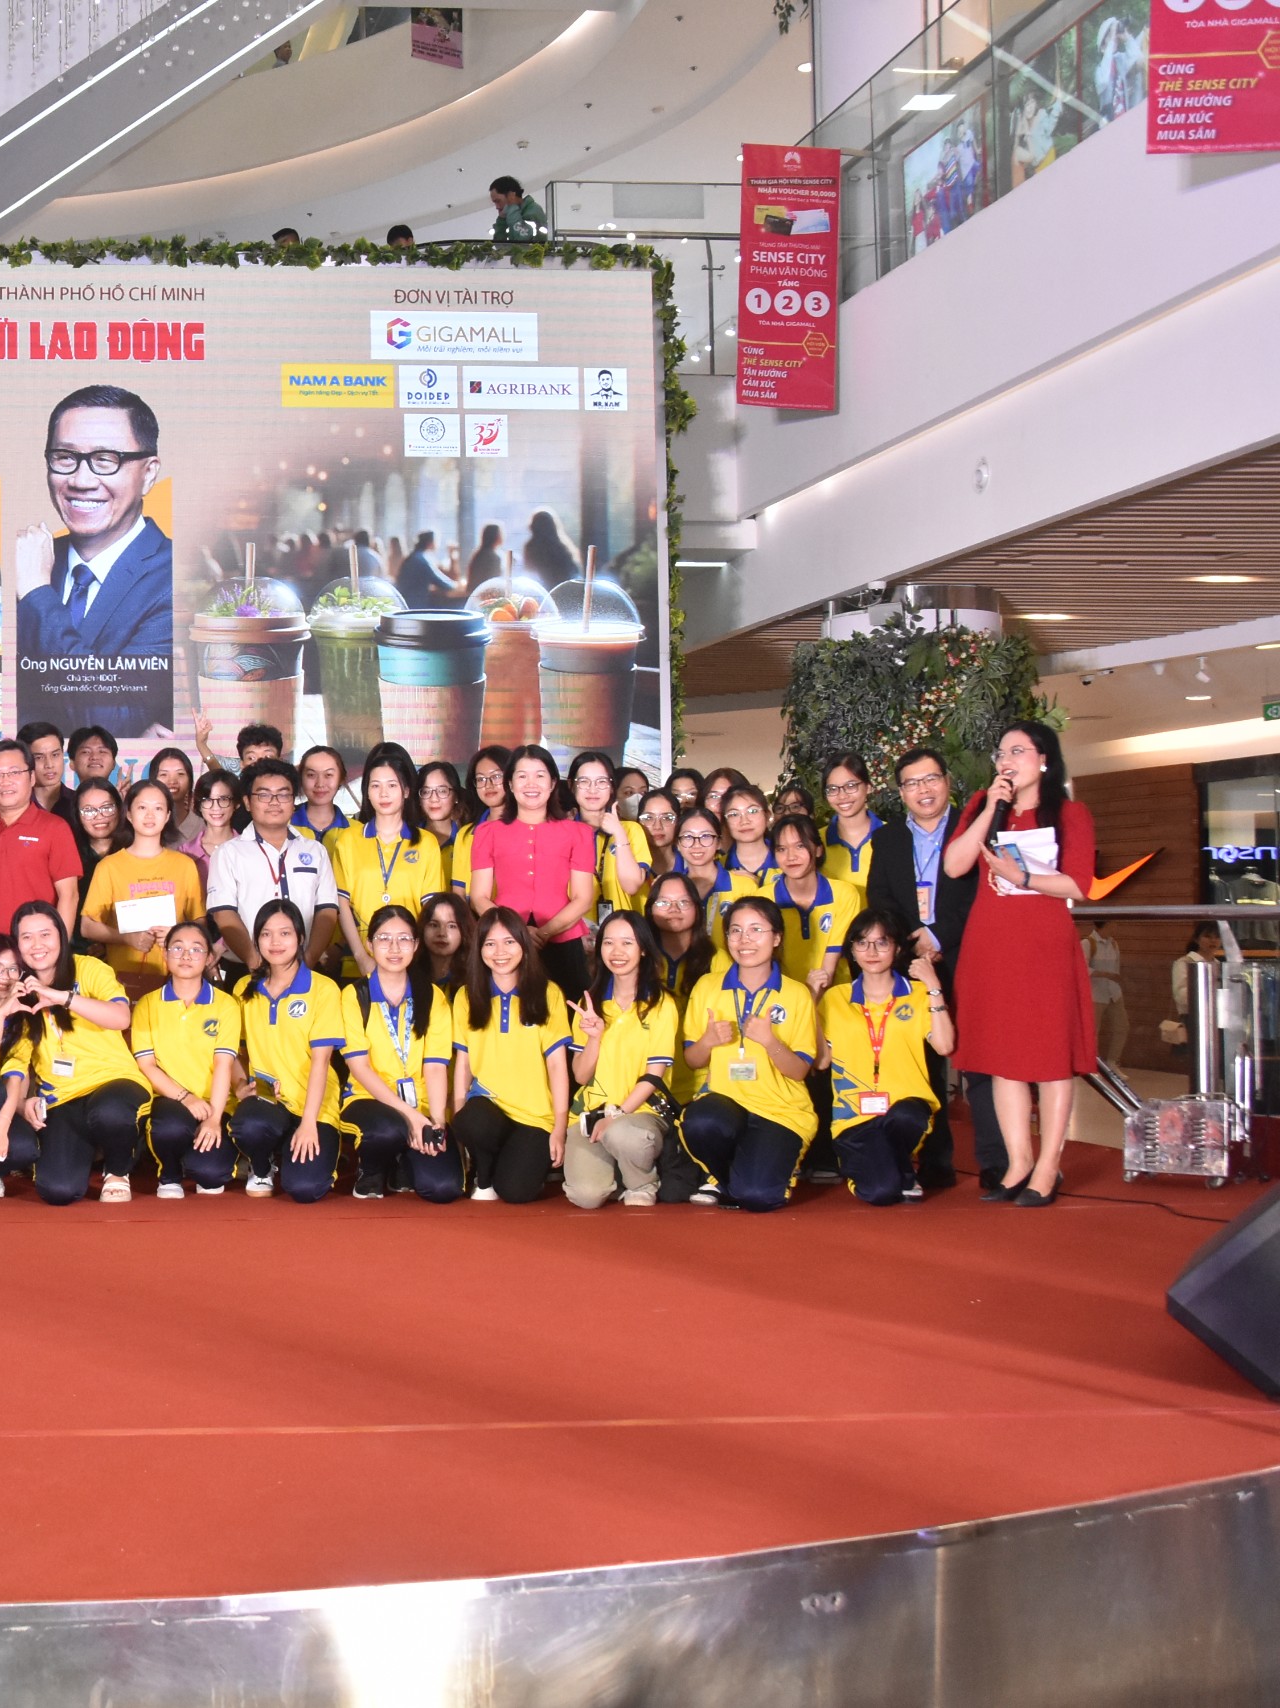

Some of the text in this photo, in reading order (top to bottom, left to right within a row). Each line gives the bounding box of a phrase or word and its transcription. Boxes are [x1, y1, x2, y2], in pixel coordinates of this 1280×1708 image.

[1231, 17, 1280, 26] GIGAMALL
[1158, 62, 1195, 75] CÙNG
[1158, 77, 1259, 92] THẺ SENSE CITY
[1158, 93, 1233, 111] TẬN HƯỞNG
[1157, 109, 1214, 125] CẢM XÚC
[1156, 130, 1186, 141] MUA
[778, 188, 810, 197] VOUCHER
[752, 250, 826, 265] SENSE CITY
[750, 265, 778, 277] PHẠM
[778, 265, 799, 276] VĂN
[60, 283, 96, 301] PHỐ
[100, 283, 125, 301] HỒ
[126, 283, 158, 301] CHÍ
[162, 287, 205, 301] MINH
[394, 287, 514, 308] ĐƠN VỊ TÀI TRỢ
[754, 294, 822, 311] 1 2 3
[29, 321, 98, 361] LAO
[106, 317, 205, 363] ĐỘNG
[416, 326, 523, 343] GIGAMALL
[742, 346, 765, 355] CÙNG
[759, 358, 783, 367] SENSE
[784, 359, 803, 368] CITY
[289, 375, 388, 387] NAM A BANK
[759, 378, 776, 388] XÚC
[407, 391, 450, 400] DOIDEP
[486, 383, 573, 396] AGRIBANK
[741, 389, 760, 398] MUA
[20, 654, 169, 673] Ông NGUYỄN LÂM VIÊN
